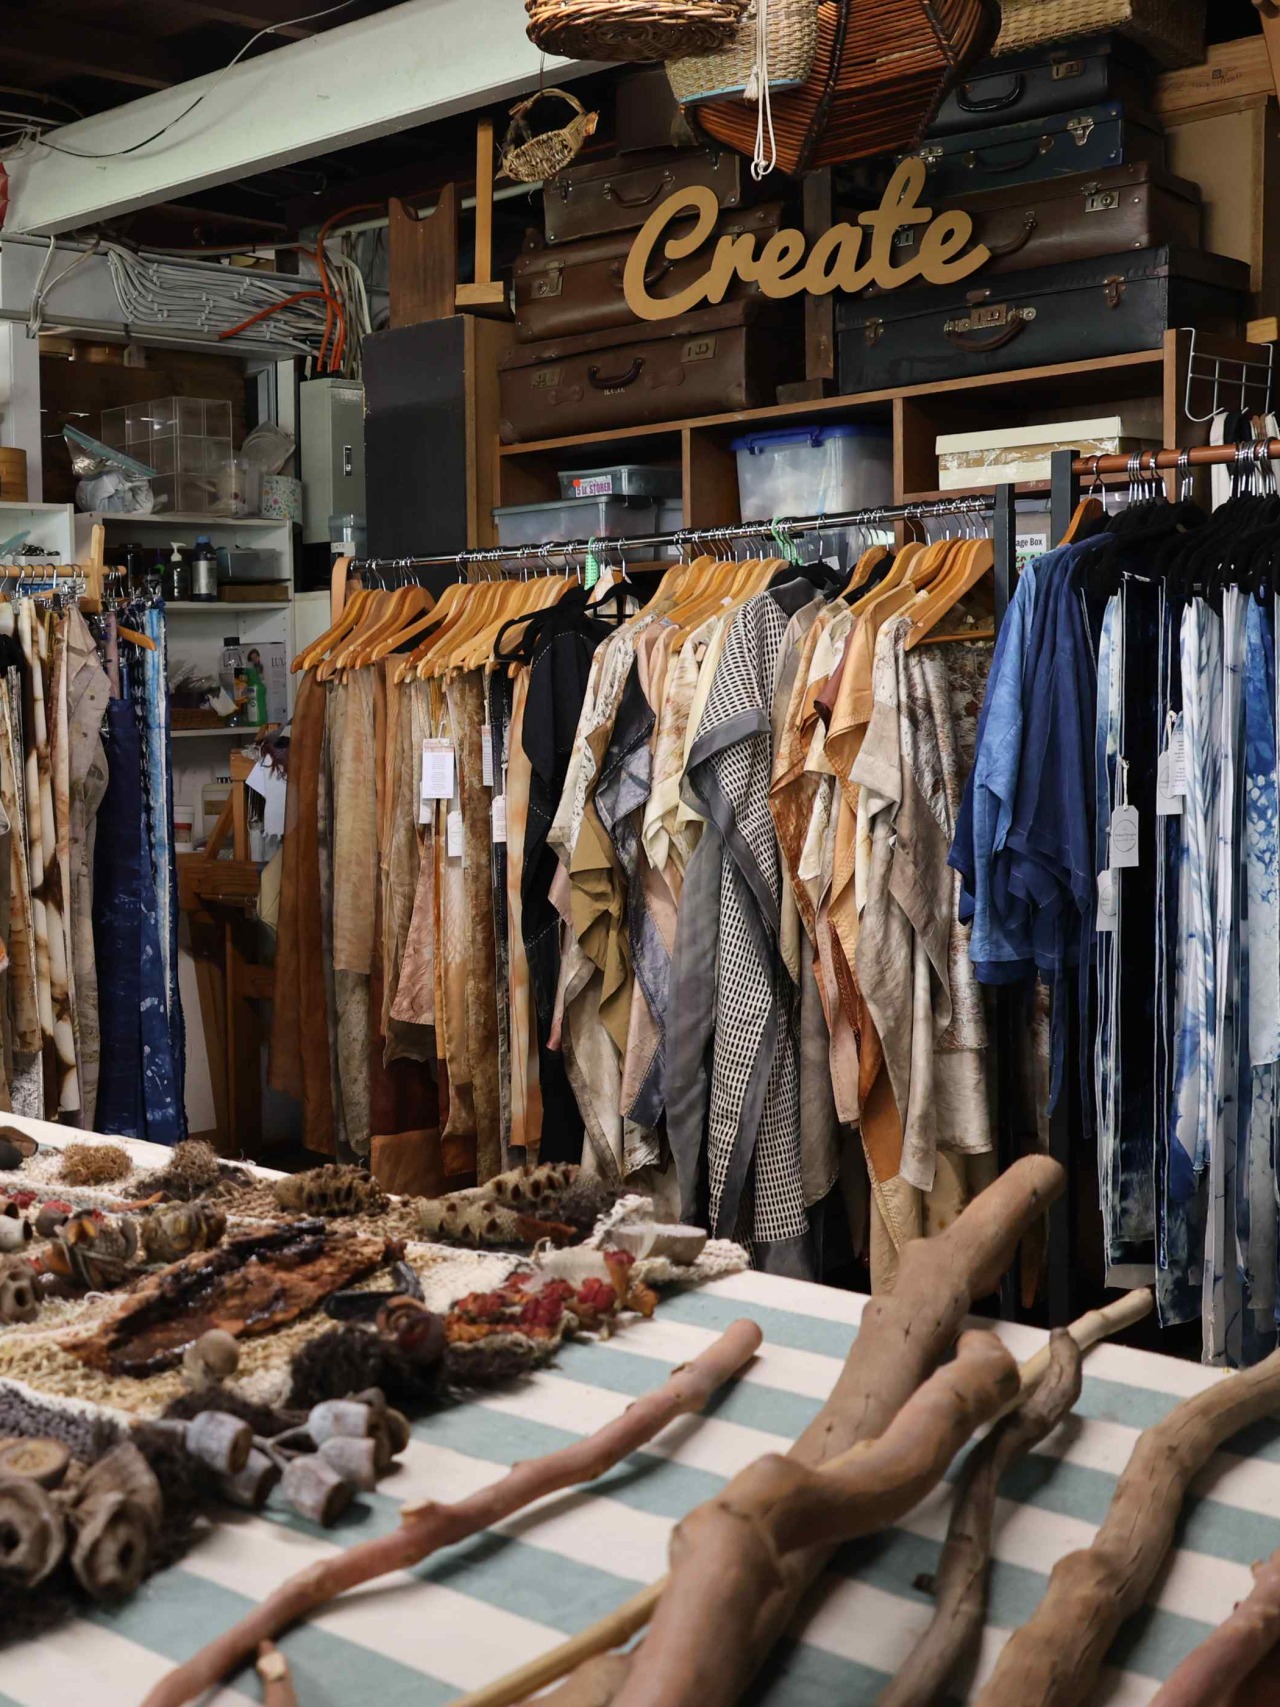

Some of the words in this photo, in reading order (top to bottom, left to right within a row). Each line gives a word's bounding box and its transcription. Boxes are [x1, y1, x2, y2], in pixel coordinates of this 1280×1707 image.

[623, 156, 991, 321] Create
[1016, 539, 1029, 549] age
[1030, 537, 1042, 546] Box
